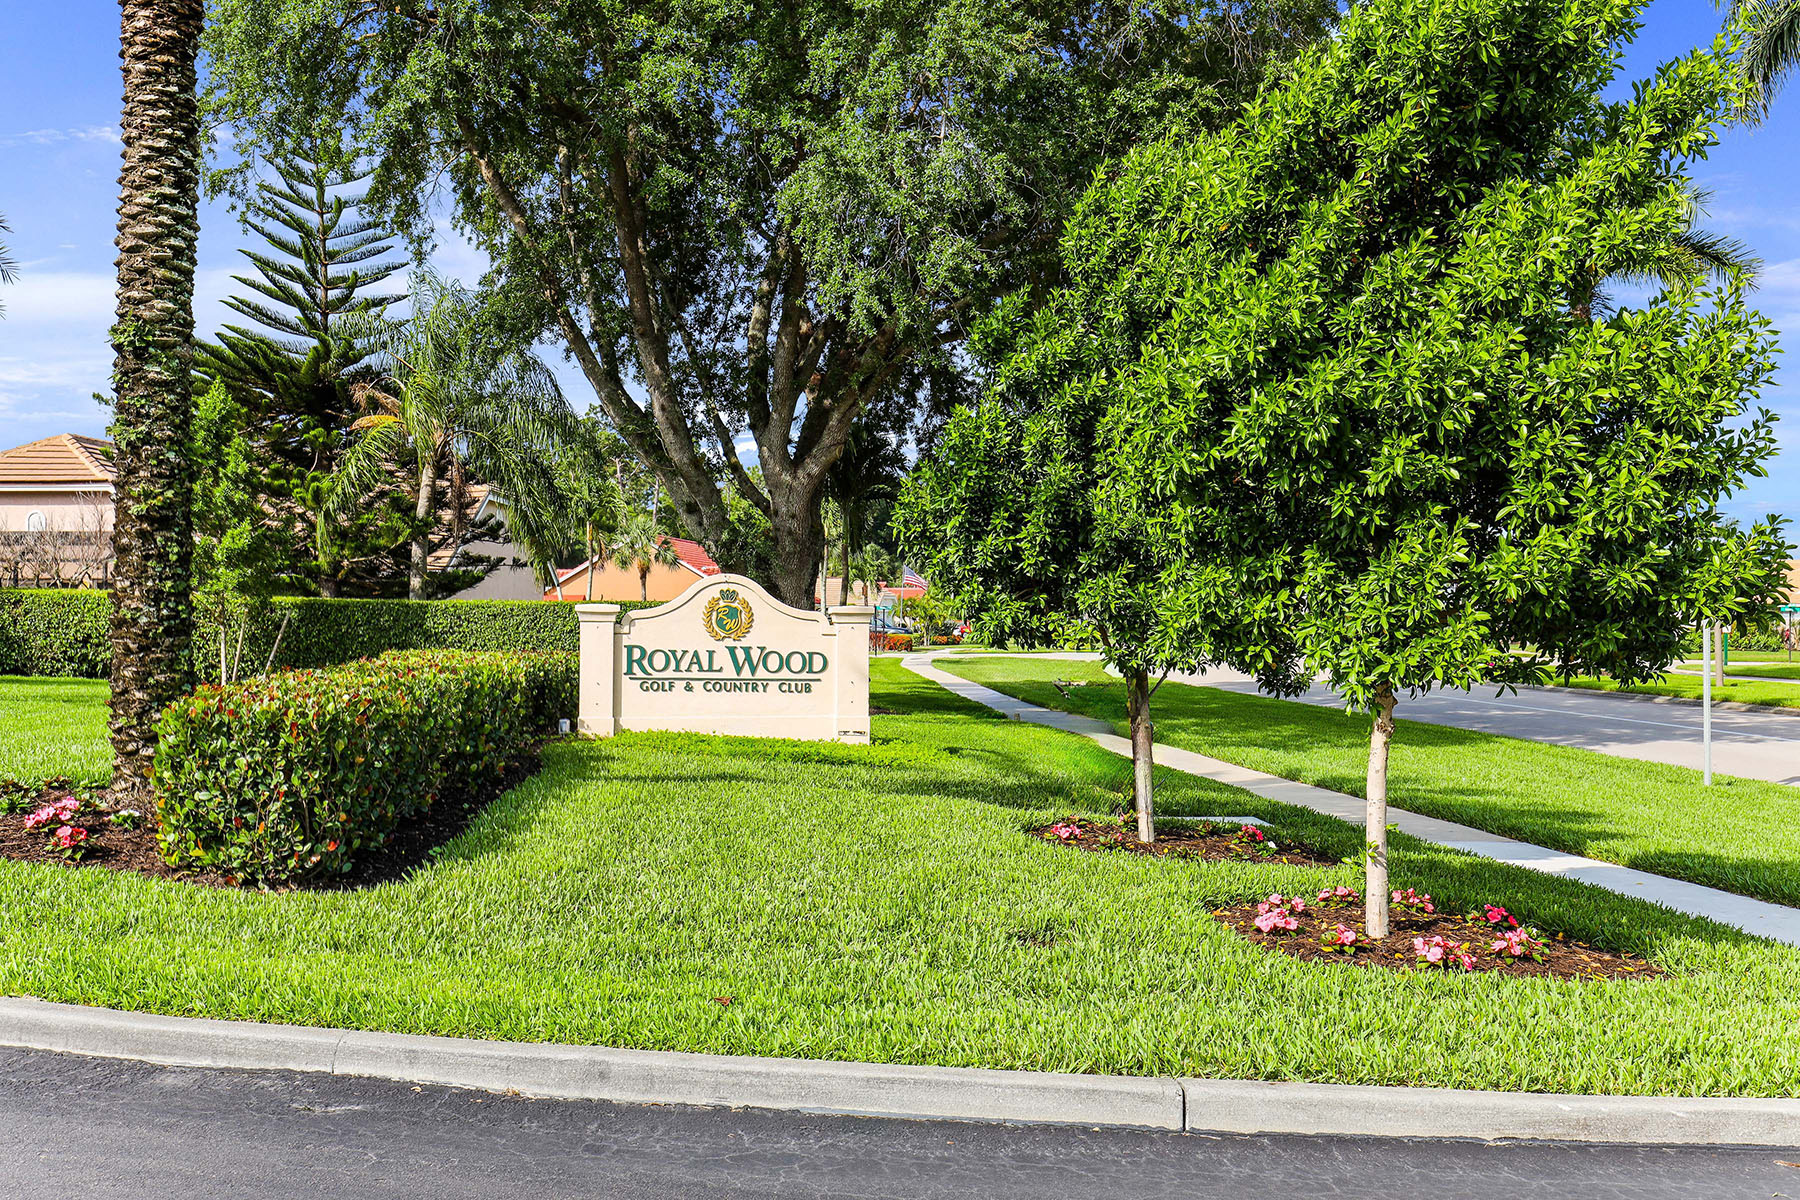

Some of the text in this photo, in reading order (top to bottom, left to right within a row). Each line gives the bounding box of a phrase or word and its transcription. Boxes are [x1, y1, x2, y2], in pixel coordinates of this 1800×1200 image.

[624, 645, 828, 677] ROYAL WOOD
[639, 681, 812, 693] GOLF & COUNTRY CLUB
